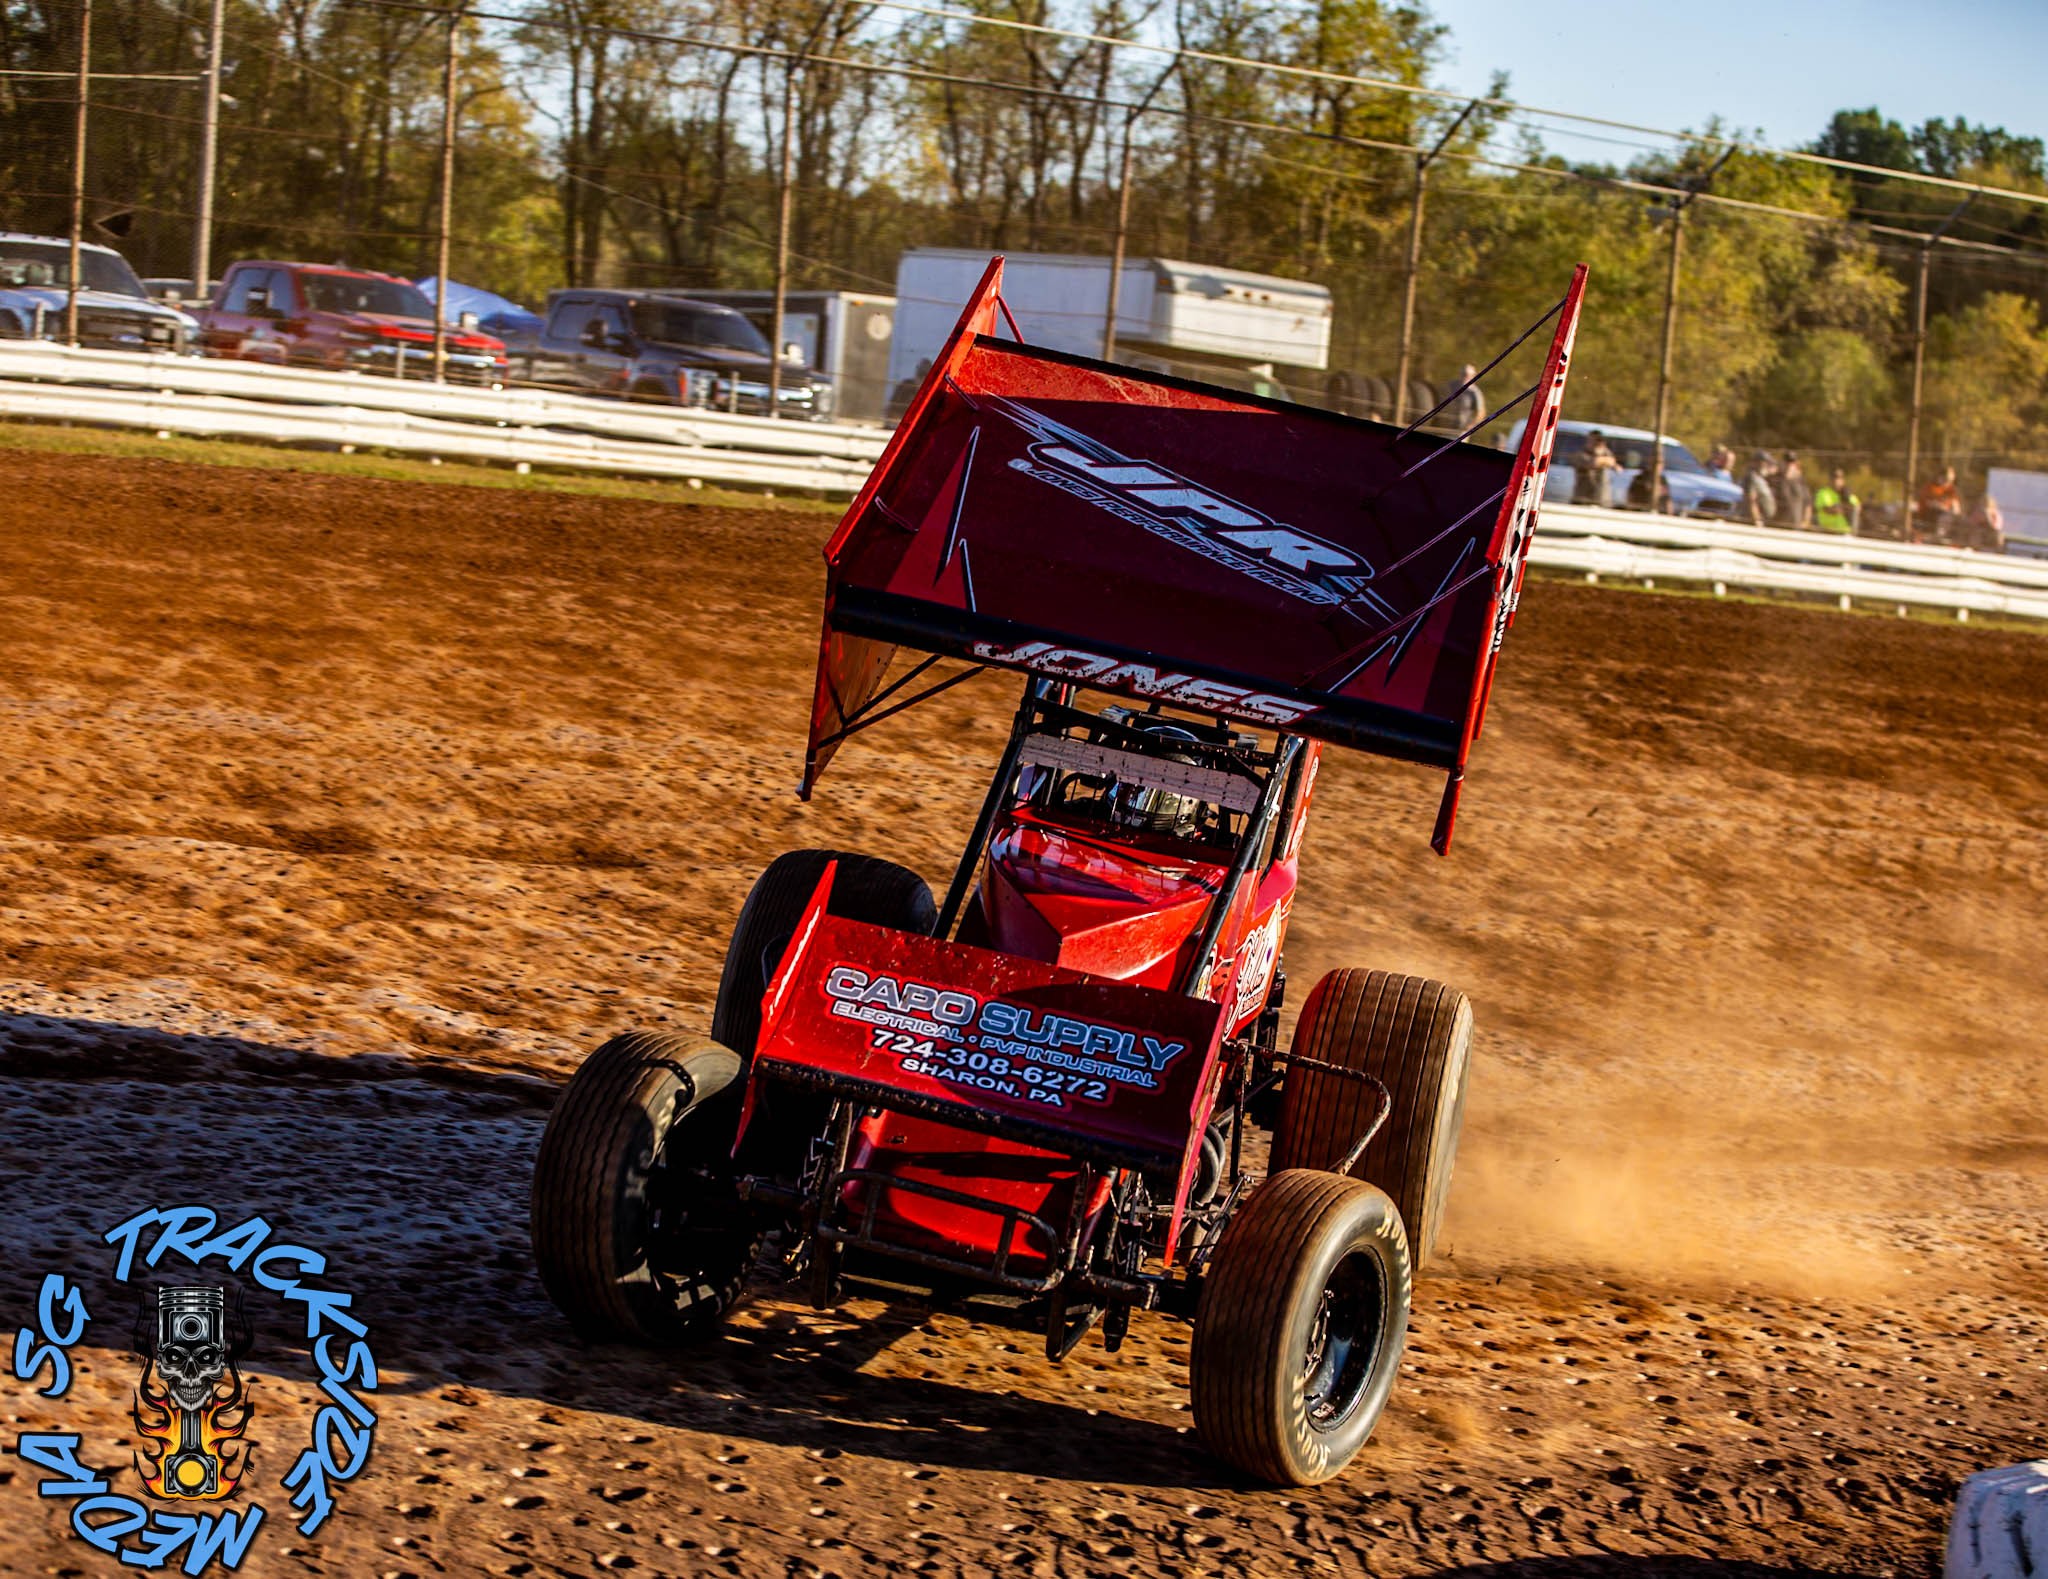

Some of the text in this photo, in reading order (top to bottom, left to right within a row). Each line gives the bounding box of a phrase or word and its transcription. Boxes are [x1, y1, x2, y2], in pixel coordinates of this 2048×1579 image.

[1024, 469, 1332, 605] JONES PERFORMANCE RACING
[1040, 446, 1358, 572] JPR
[973, 641, 1322, 725] JONES
[825, 967, 1184, 1070] CAPO SUPPLY
[832, 1001, 965, 1043] ELECTRICAL
[1026, 1046, 1158, 1087] INDUSTRIAL
[873, 1029, 1107, 1099] 724-308-6272
[901, 1058, 1063, 1106] SHARON, PA
